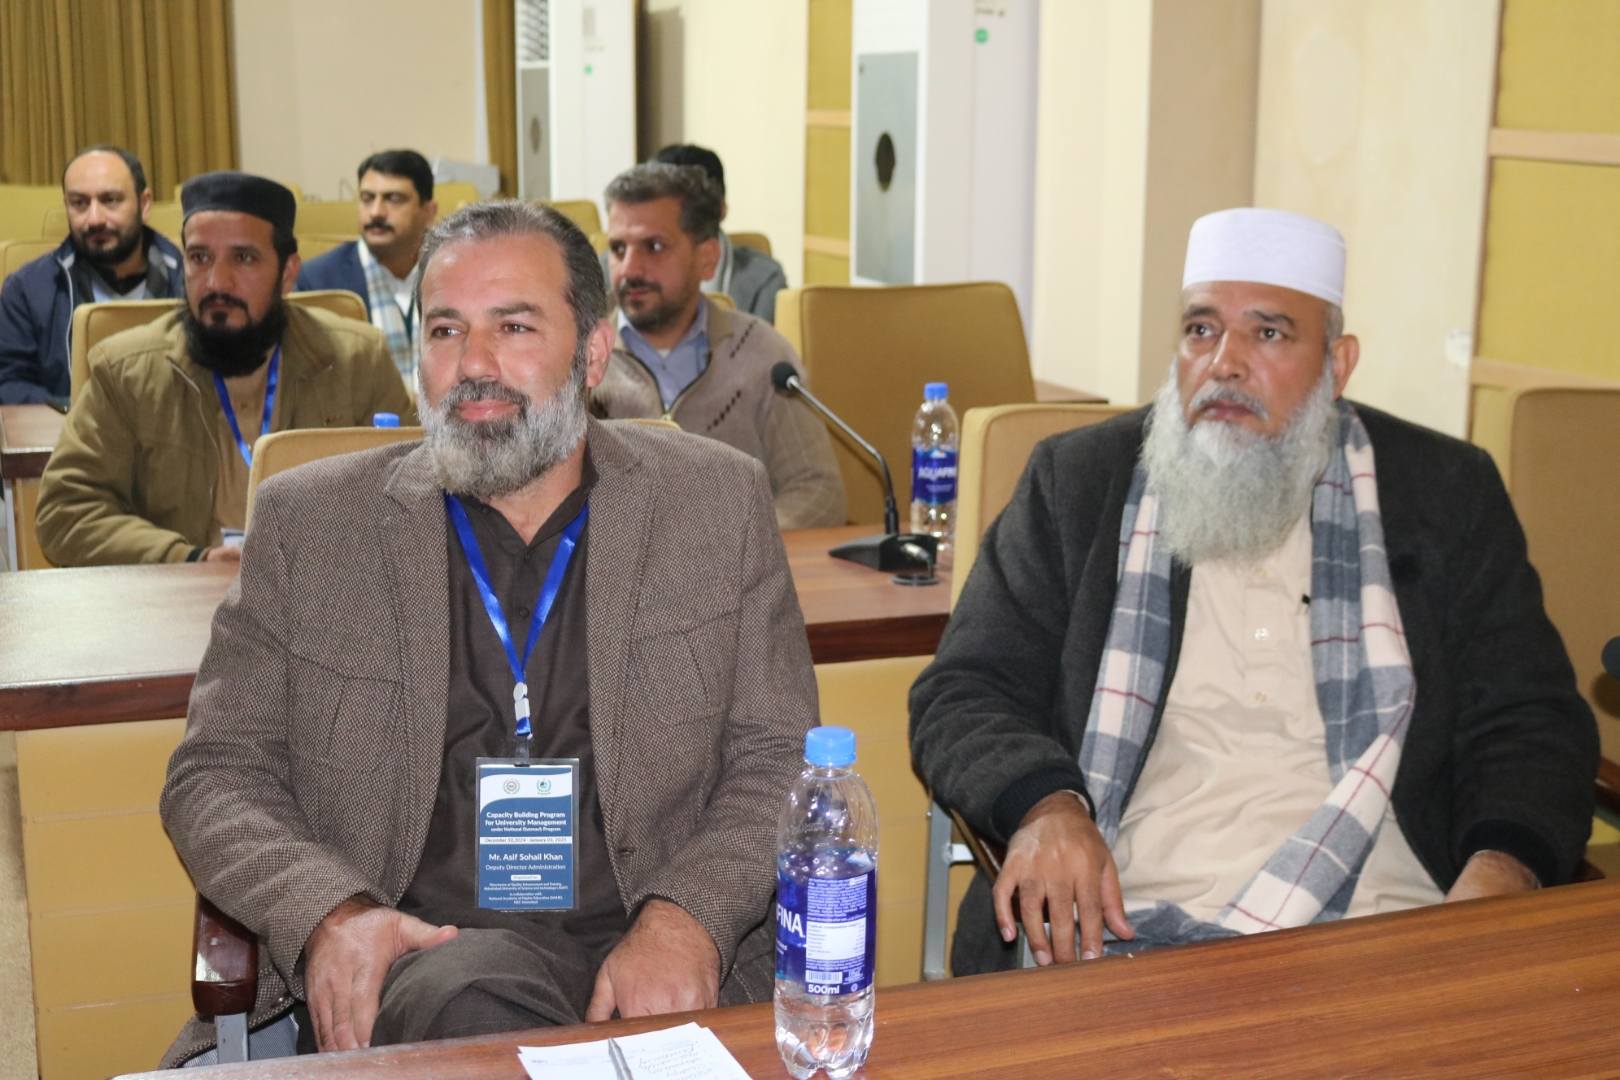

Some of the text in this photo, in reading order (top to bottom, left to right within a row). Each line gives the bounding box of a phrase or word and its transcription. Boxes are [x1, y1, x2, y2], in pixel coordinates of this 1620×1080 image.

[486, 811, 565, 820] Capacity Building Program
[485, 819, 567, 828] for University Management
[488, 853, 502, 861] Mr.
[502, 853, 518, 861] Asif
[519, 853, 542, 861] Sohail
[808, 984, 840, 994] 500ml
